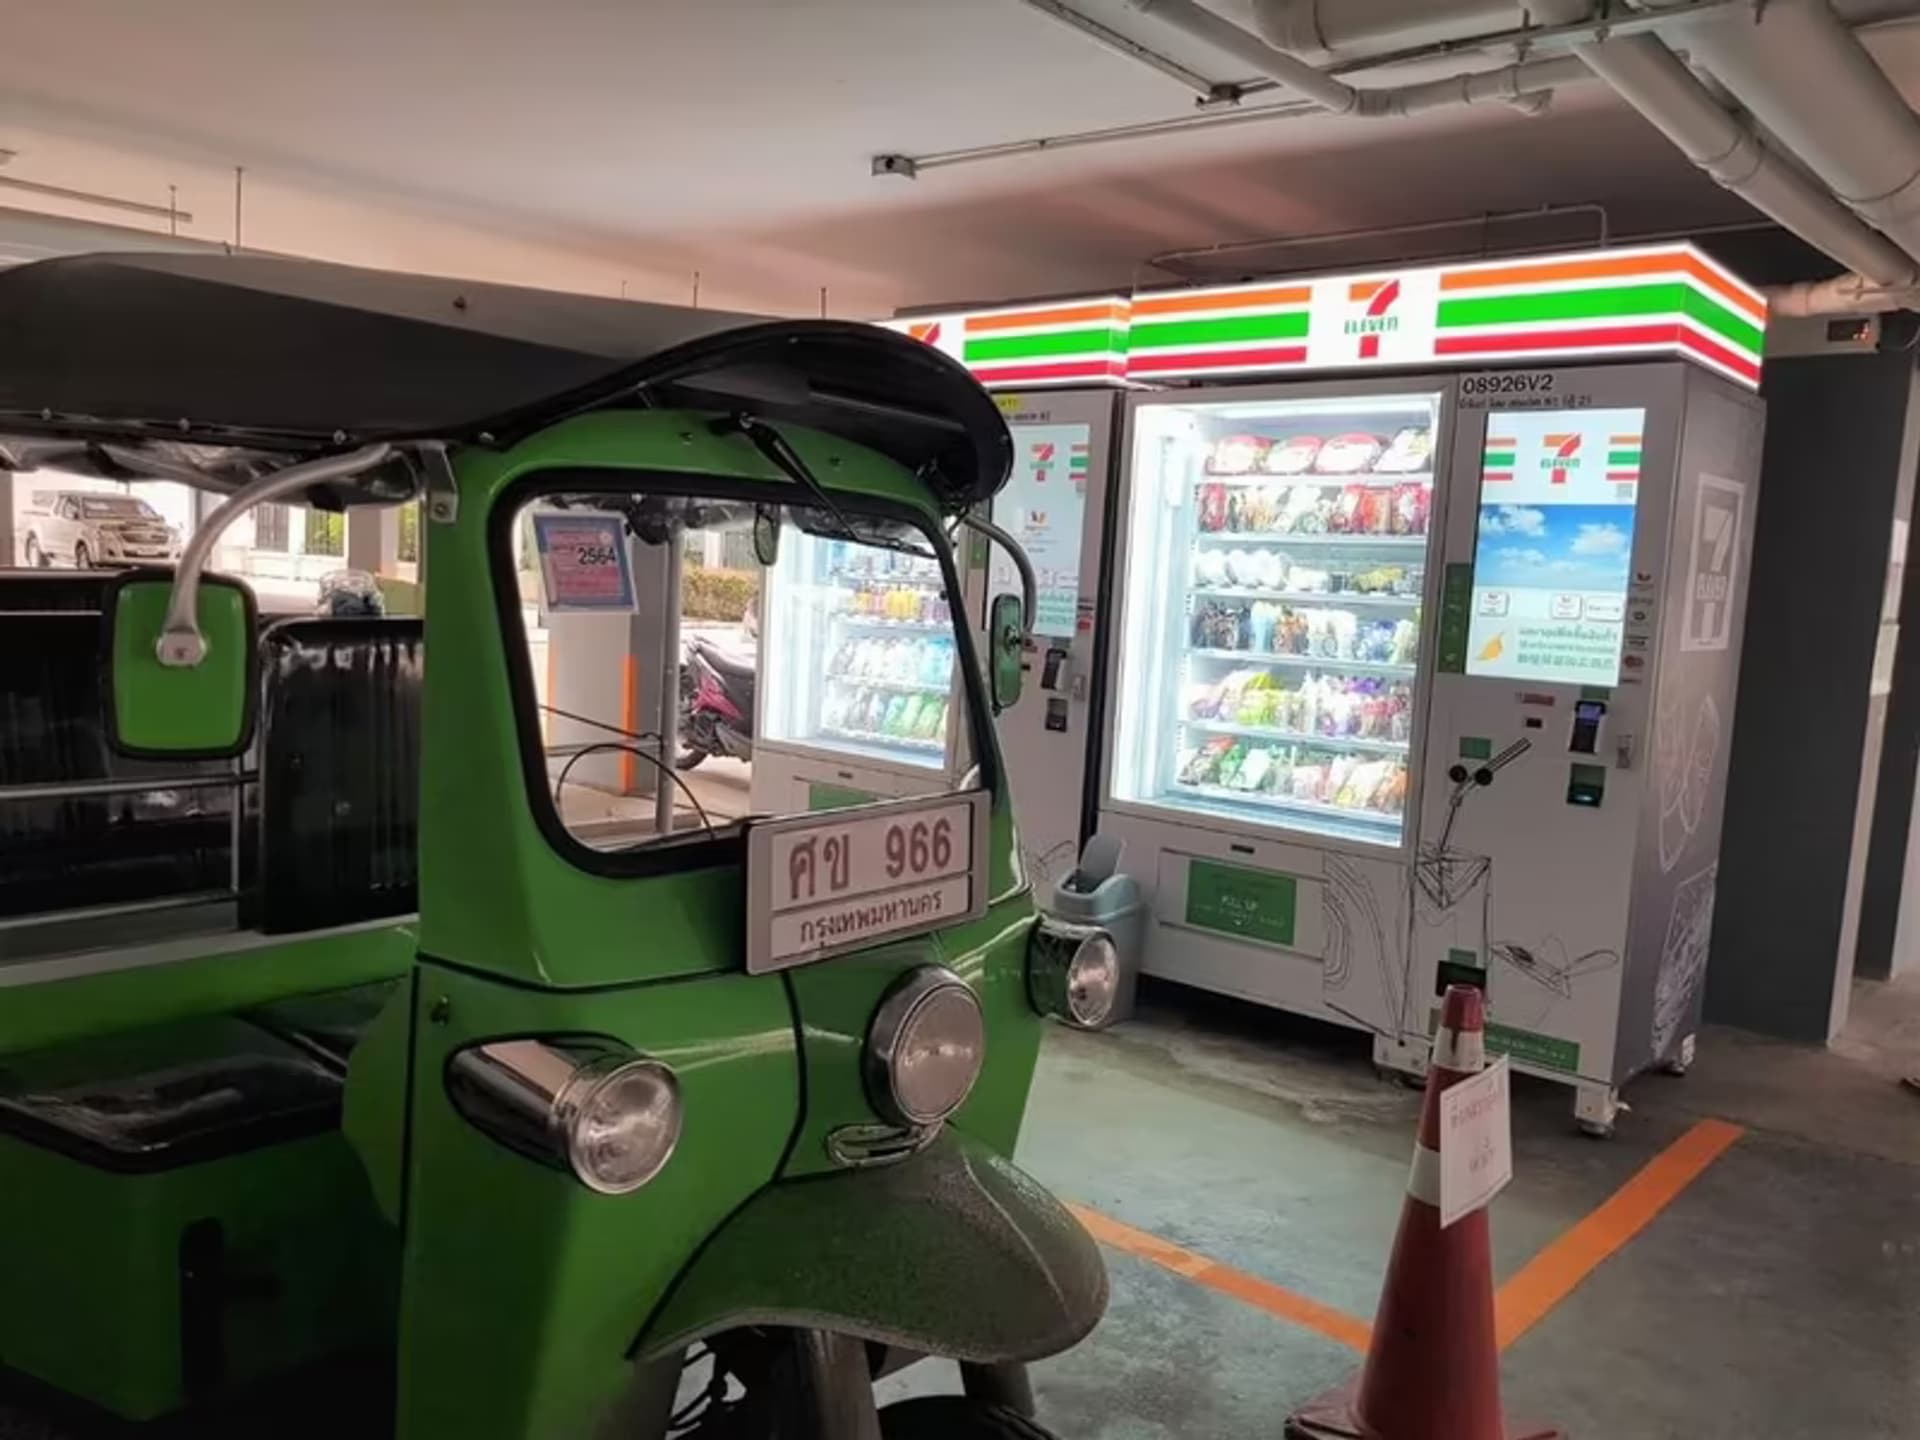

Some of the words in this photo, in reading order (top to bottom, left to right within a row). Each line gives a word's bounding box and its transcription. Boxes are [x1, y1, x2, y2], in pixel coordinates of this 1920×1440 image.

[1462, 374, 1555, 395] 08926V2
[577, 546, 616, 566] 2564
[789, 833, 850, 900] ศข
[885, 818, 953, 878] 966
[800, 890, 943, 950] กรุงเทพมหานคร
